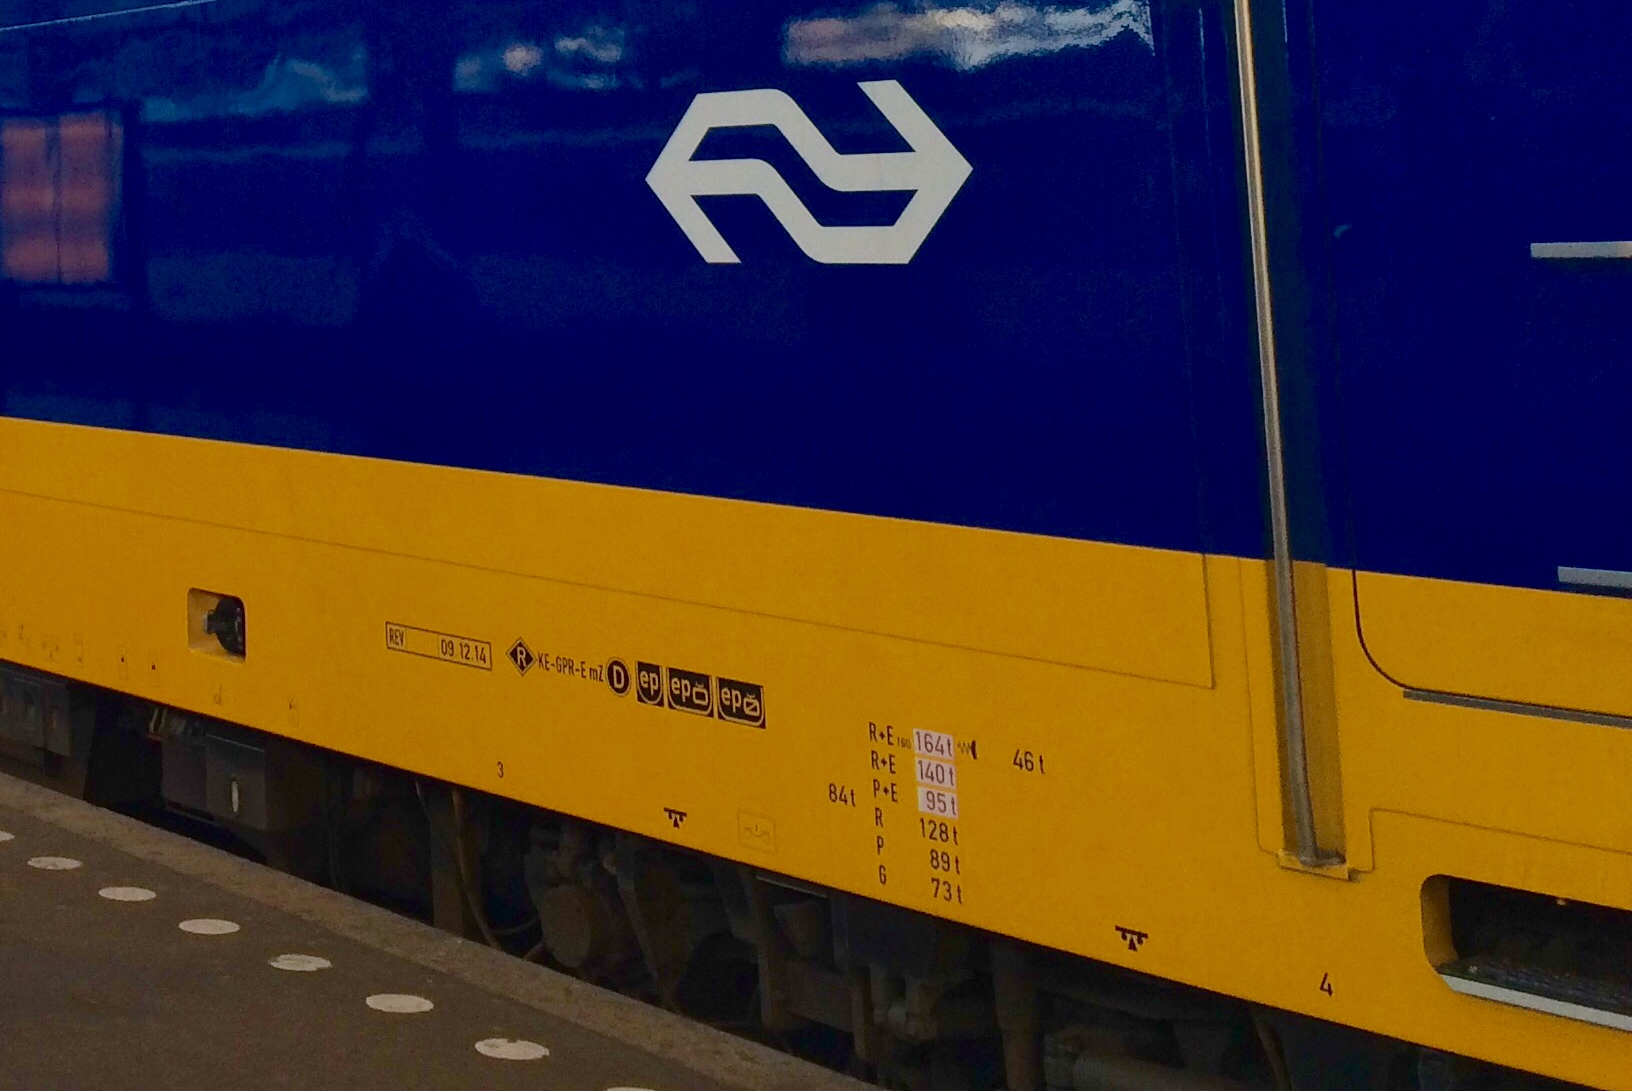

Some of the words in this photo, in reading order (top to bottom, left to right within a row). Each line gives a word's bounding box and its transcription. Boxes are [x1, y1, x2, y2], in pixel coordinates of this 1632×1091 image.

[389, 628, 404, 646] REV
[537, 652, 586, 679] KE-GPR-E
[869, 721, 894, 746] R+E
[497, 761, 504, 778] 3
[871, 750, 896, 775] R+E
[875, 807, 883, 828] R
[876, 835, 884, 856] P
[1319, 972, 1333, 997] 4
